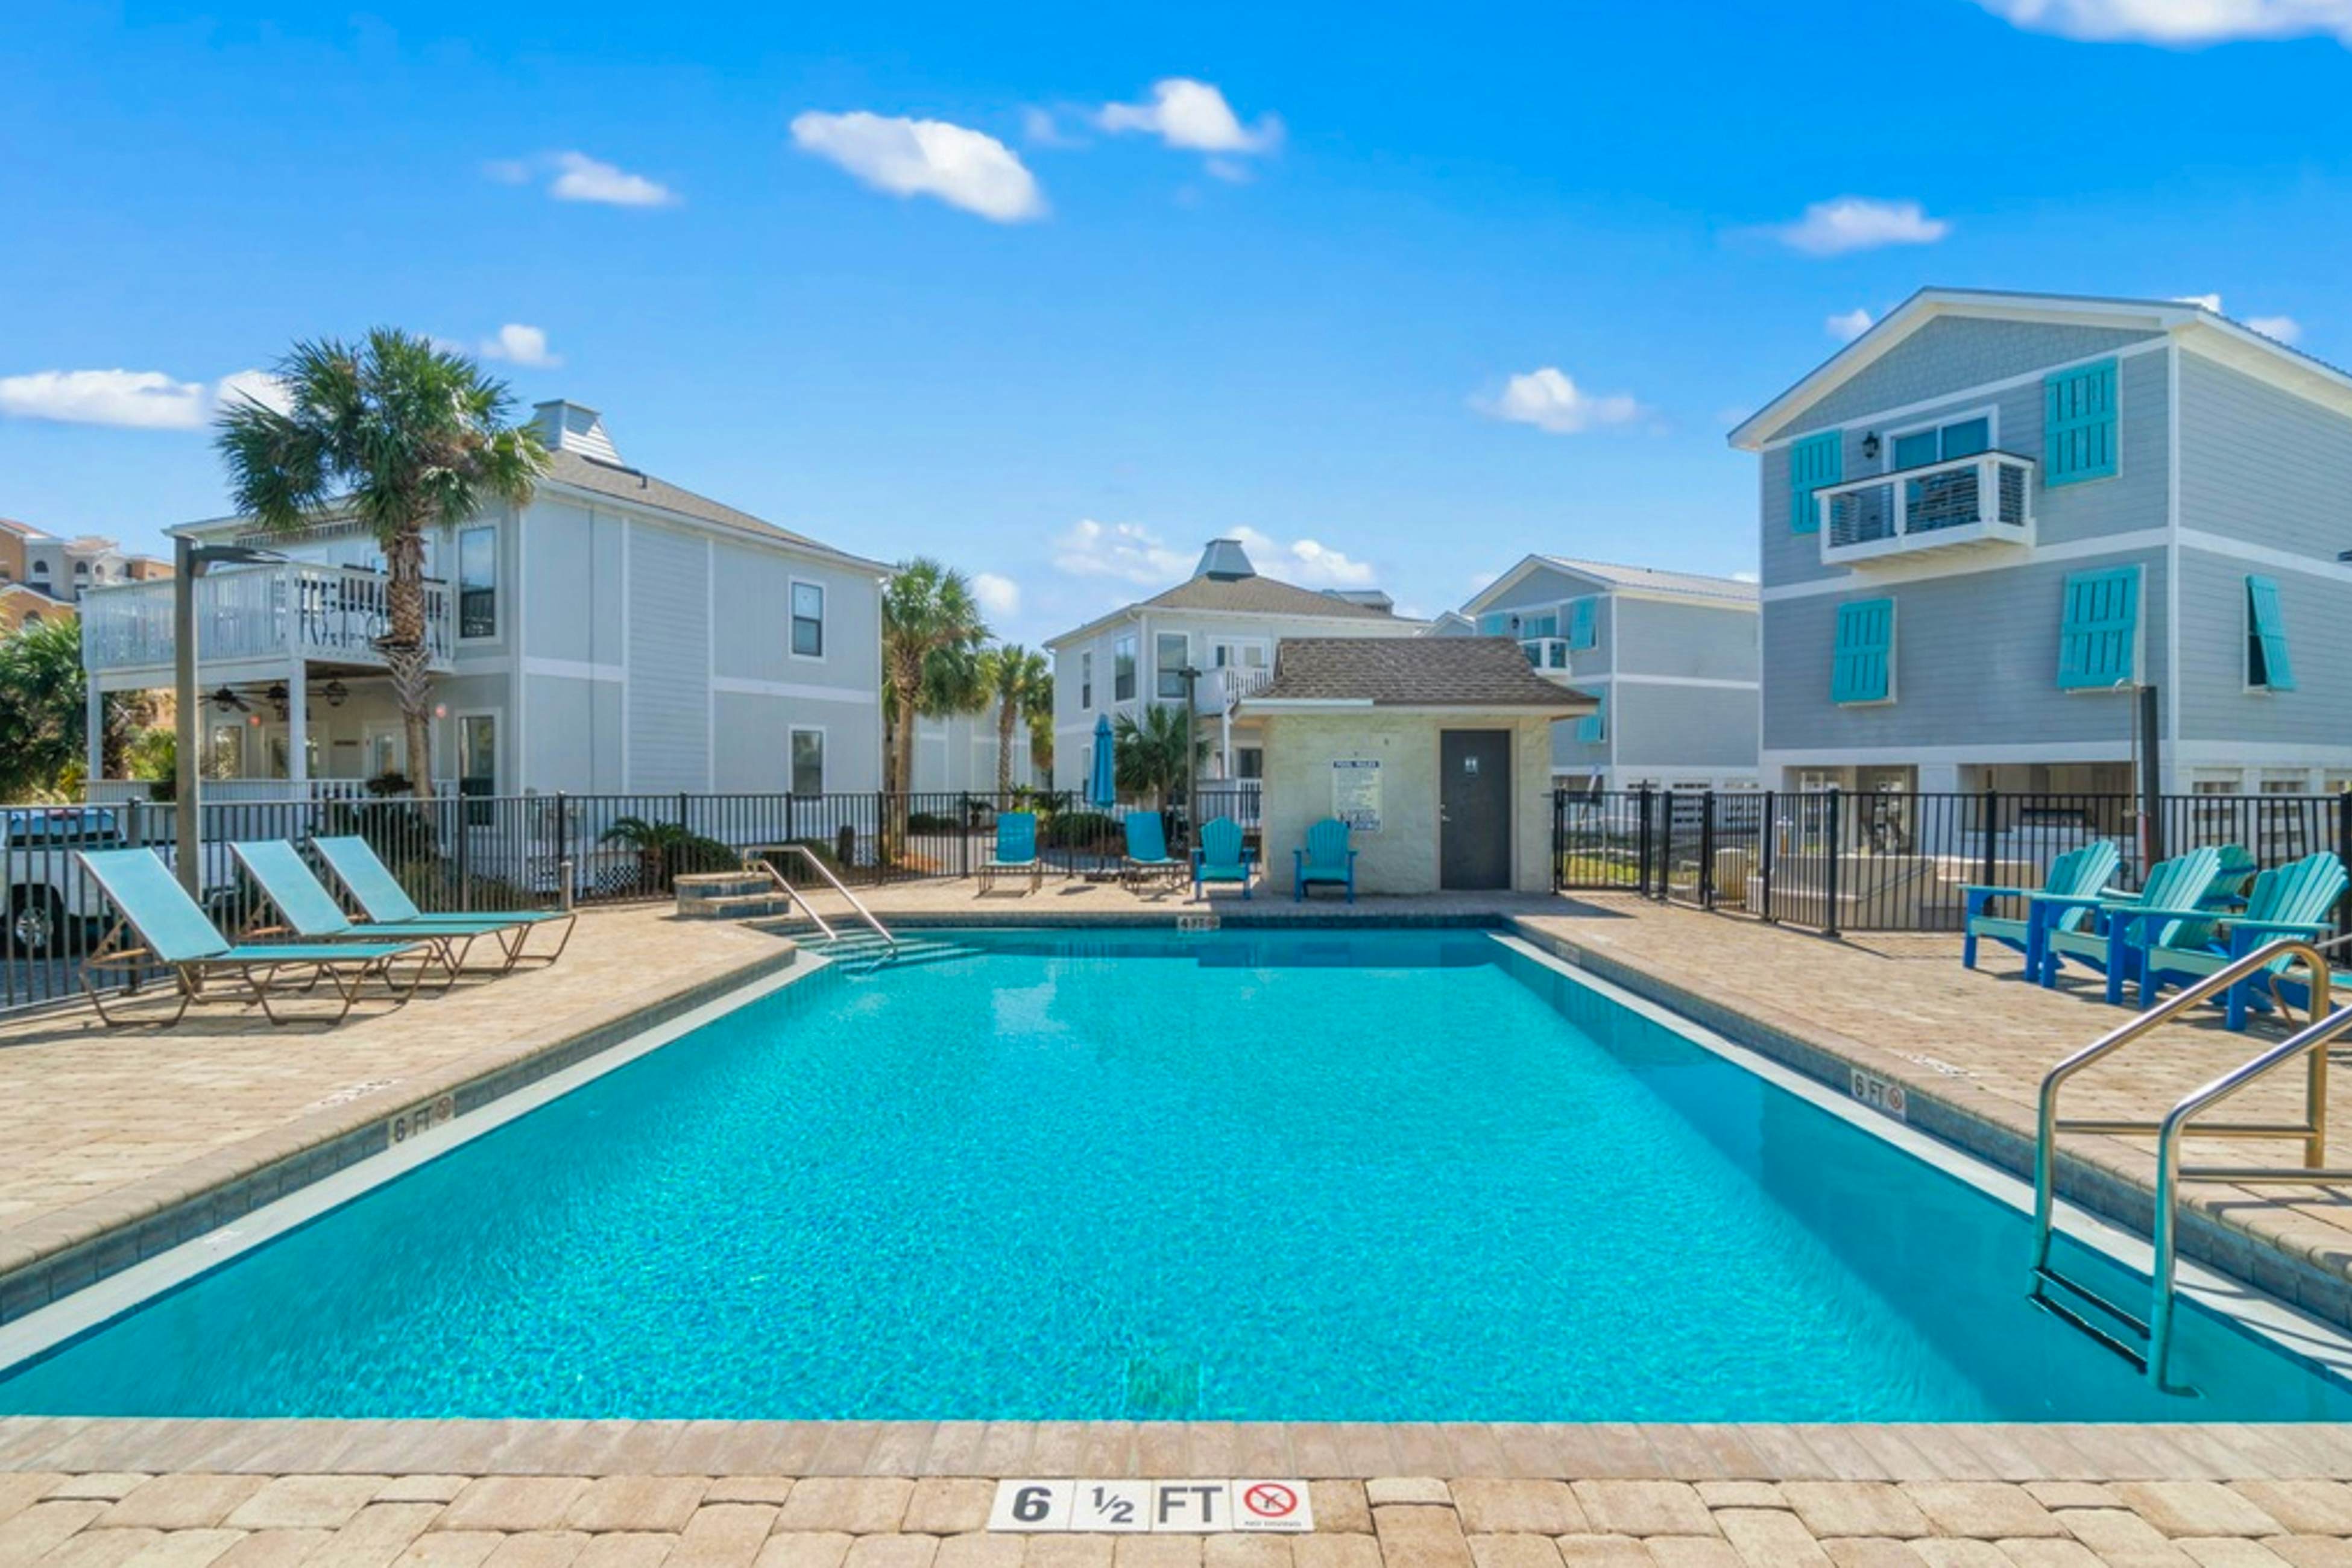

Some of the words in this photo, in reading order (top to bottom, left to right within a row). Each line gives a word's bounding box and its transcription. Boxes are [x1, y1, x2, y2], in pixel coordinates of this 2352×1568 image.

[1855, 1074, 1864, 1097] 6
[1870, 1080, 1885, 1106] FT
[394, 1117, 406, 1143] 6
[414, 1105, 432, 1136] FT
[1012, 1486, 1052, 1522] 6
[1159, 1486, 1223, 1523] FT
